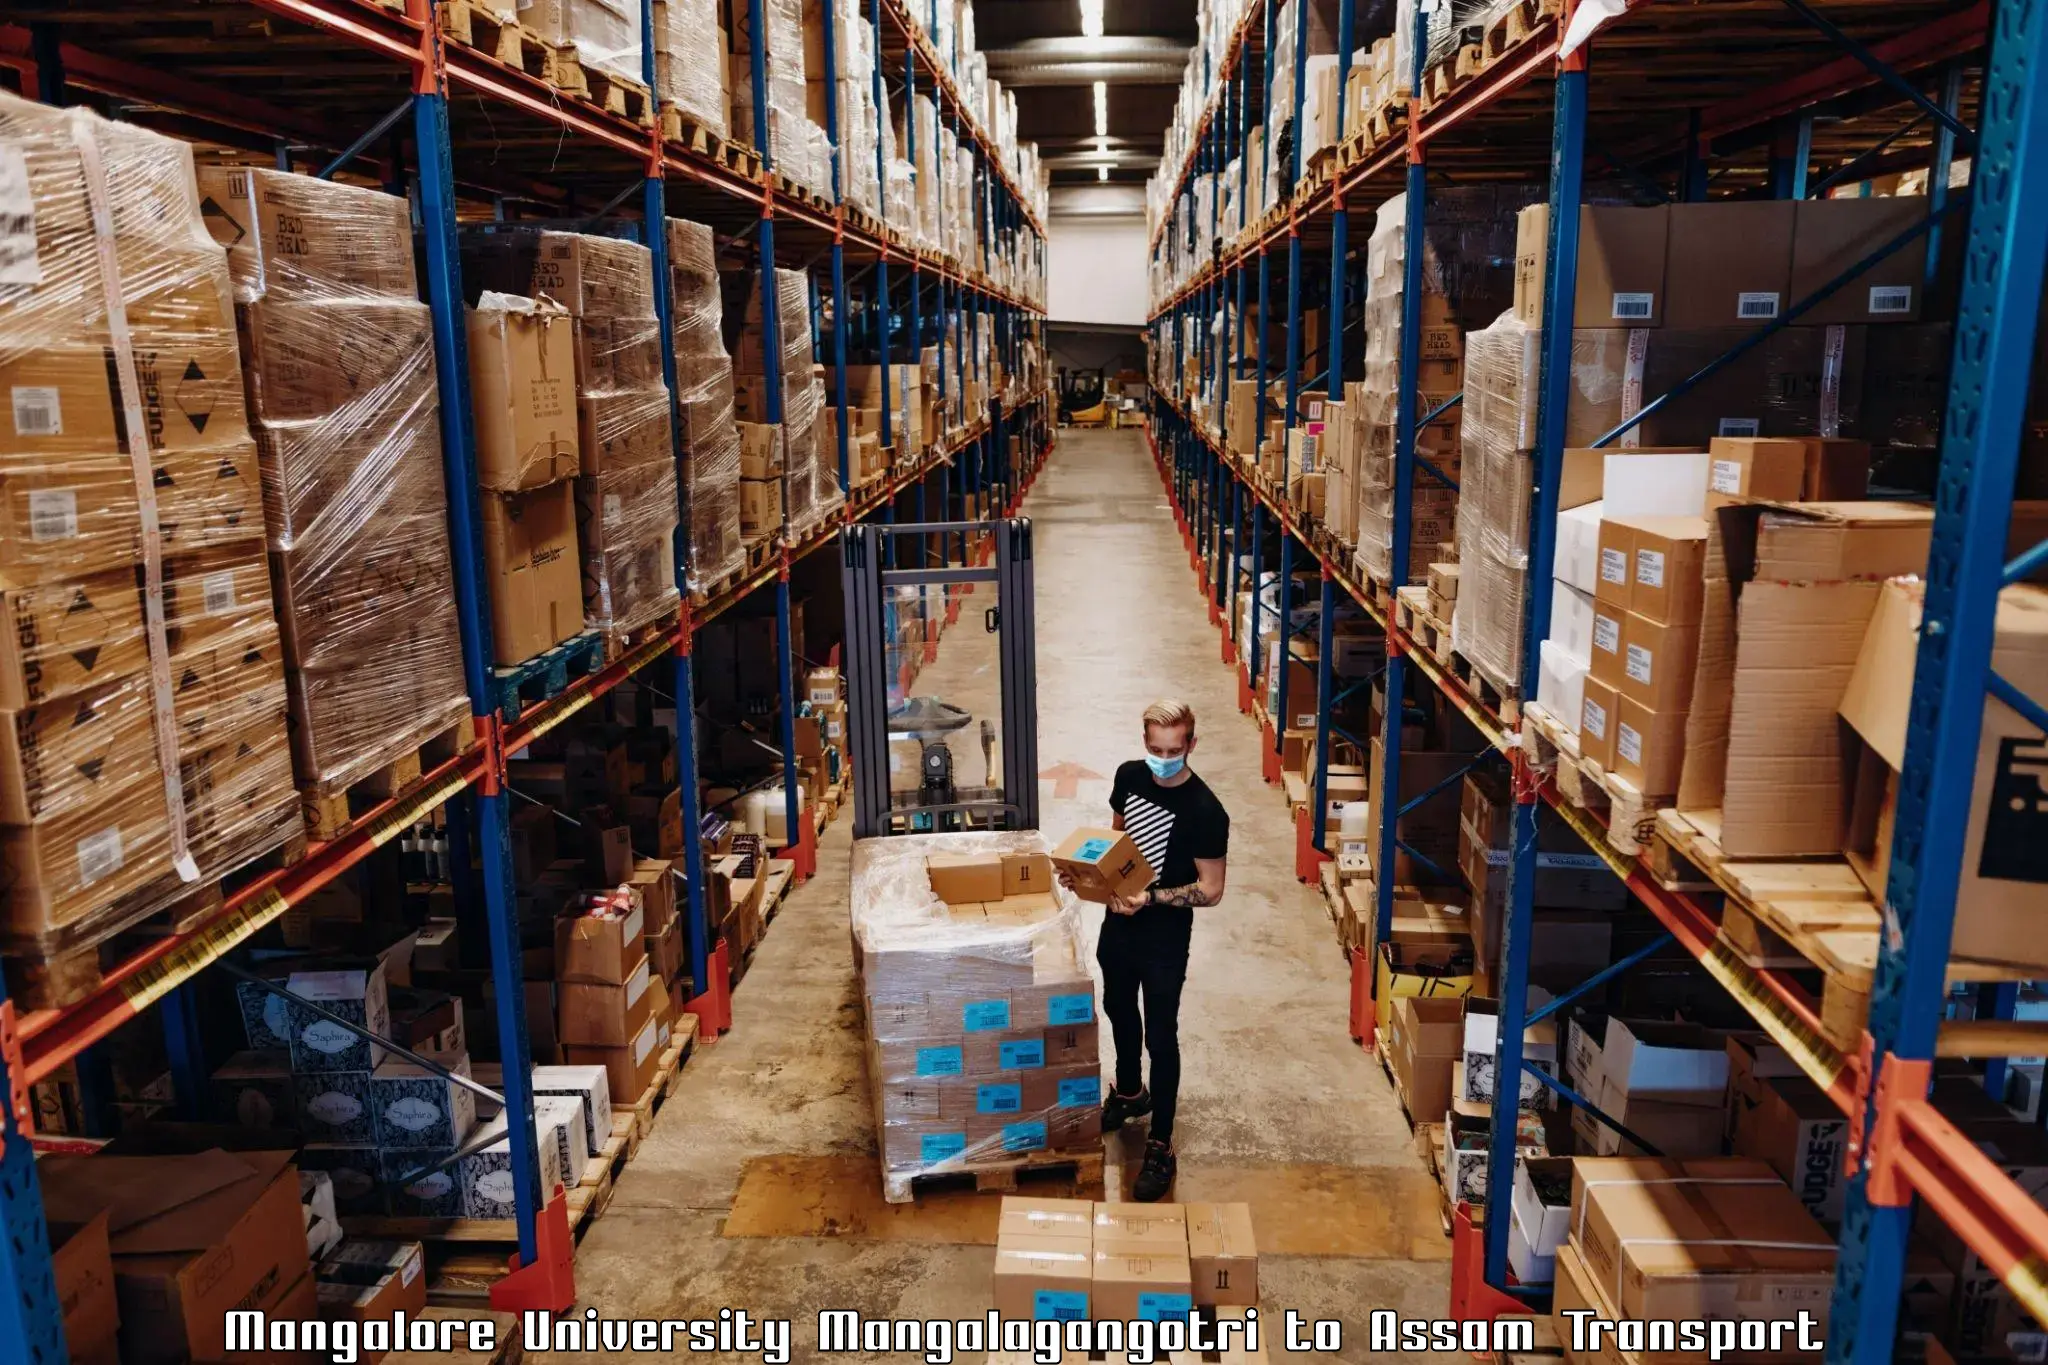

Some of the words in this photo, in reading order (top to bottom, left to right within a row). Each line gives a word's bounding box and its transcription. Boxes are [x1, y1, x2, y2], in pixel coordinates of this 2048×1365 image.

[276, 213, 303, 234] BED
[276, 235, 309, 255] HEAD
[531, 262, 560, 275] BED
[1426, 341, 1451, 349] HEAD
[1429, 332, 1448, 341] BED
[142, 371, 166, 449] FUDGE
[18, 613, 44, 702] FUDGE
[309, 1029, 350, 1047] Saphira
[392, 1109, 432, 1124] Saphira
